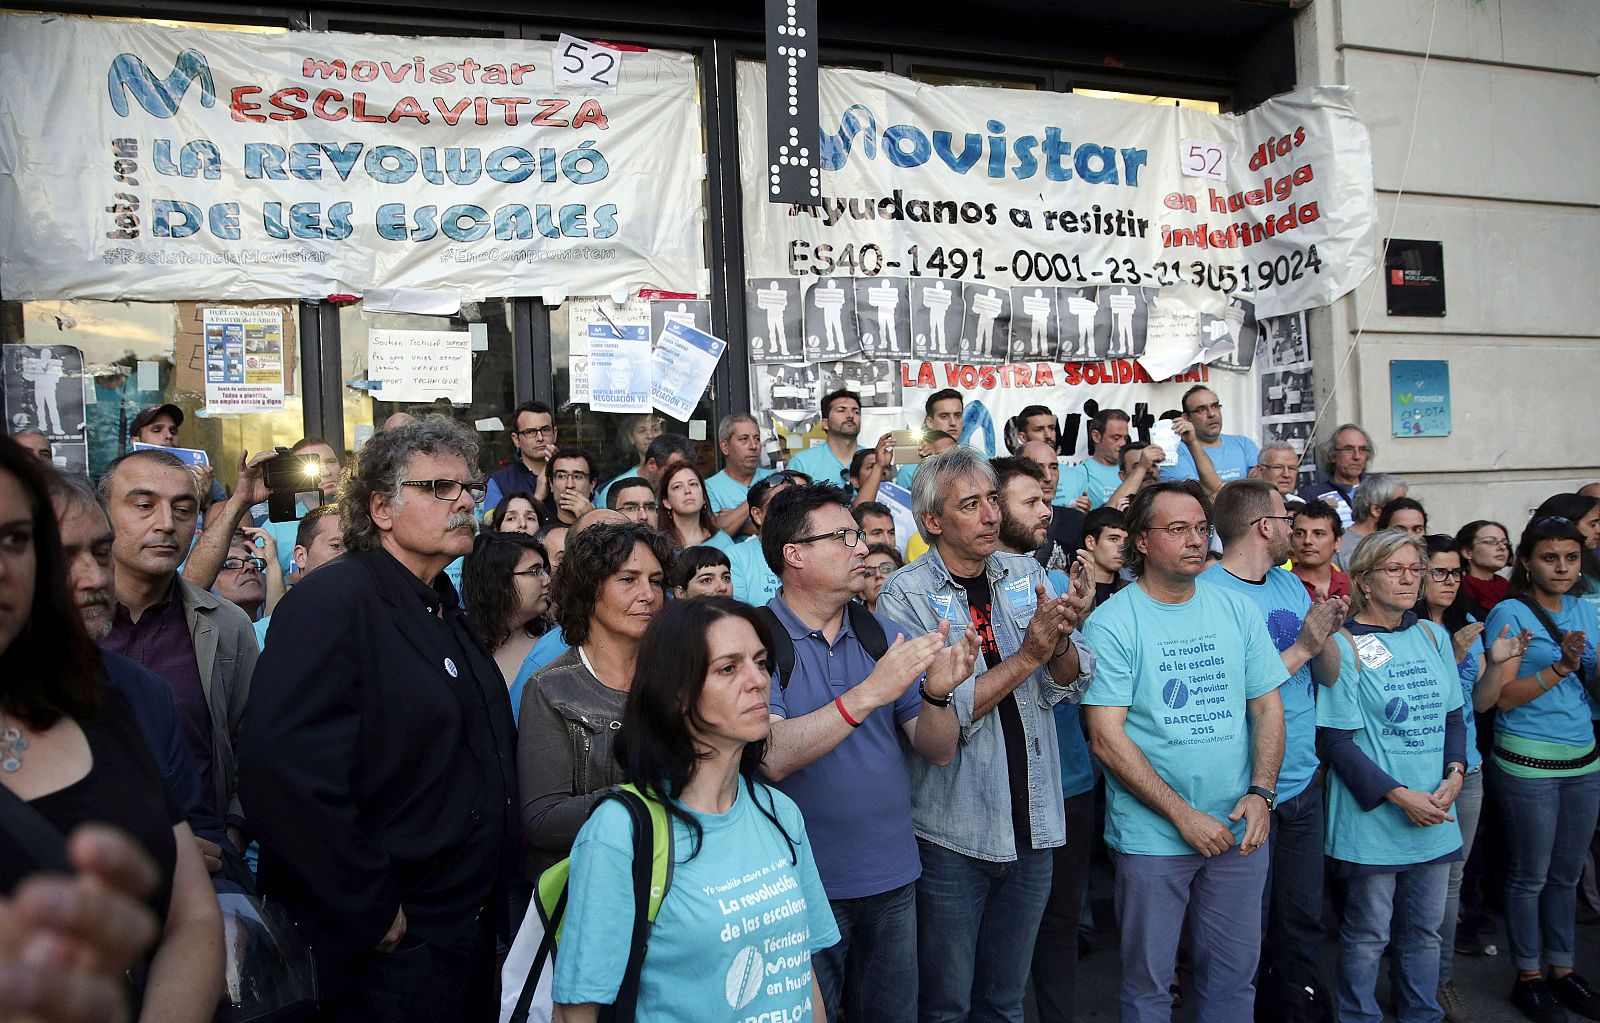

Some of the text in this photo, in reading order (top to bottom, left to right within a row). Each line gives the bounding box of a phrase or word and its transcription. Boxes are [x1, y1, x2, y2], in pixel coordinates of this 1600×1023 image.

[302, 56, 536, 85] movistar
[563, 42, 615, 86] 52
[229, 86, 609, 130] ESCLAVITZA
[153, 139, 609, 186] LA REVOLUCIÓ
[1188, 146, 1223, 176] 52
[1249, 125, 1306, 172] días
[1163, 163, 1314, 214] en huelga
[152, 200, 619, 243] DE LES ESCALES
[1009, 207, 1033, 230] a
[1044, 204, 1150, 240] resistir
[1161, 200, 1320, 250] indefinida
[902, 361, 938, 390] LA
[945, 363, 1055, 391] VOSTRA
[593, 393, 635, 402] NEGOCIACIÓN
[1159, 656, 1225, 672] de les escales
[1162, 643, 1216, 657] La revolta
[1188, 671, 1226, 684] Tècnics de
[1190, 683, 1229, 697] Movistar
[1383, 681, 1396, 692] de
[1406, 678, 1438, 690] escales
[1206, 696, 1226, 705] vaga
[1163, 709, 1233, 725] BARCELONA
[1190, 725, 1215, 736] 2015
[1382, 724, 1445, 737] BARCELONA
[702, 886, 715, 896] Yo
[718, 874, 798, 916] La revolución
[720, 922, 741, 943] de
[742, 912, 760, 935] las
[766, 981, 782, 996] en
